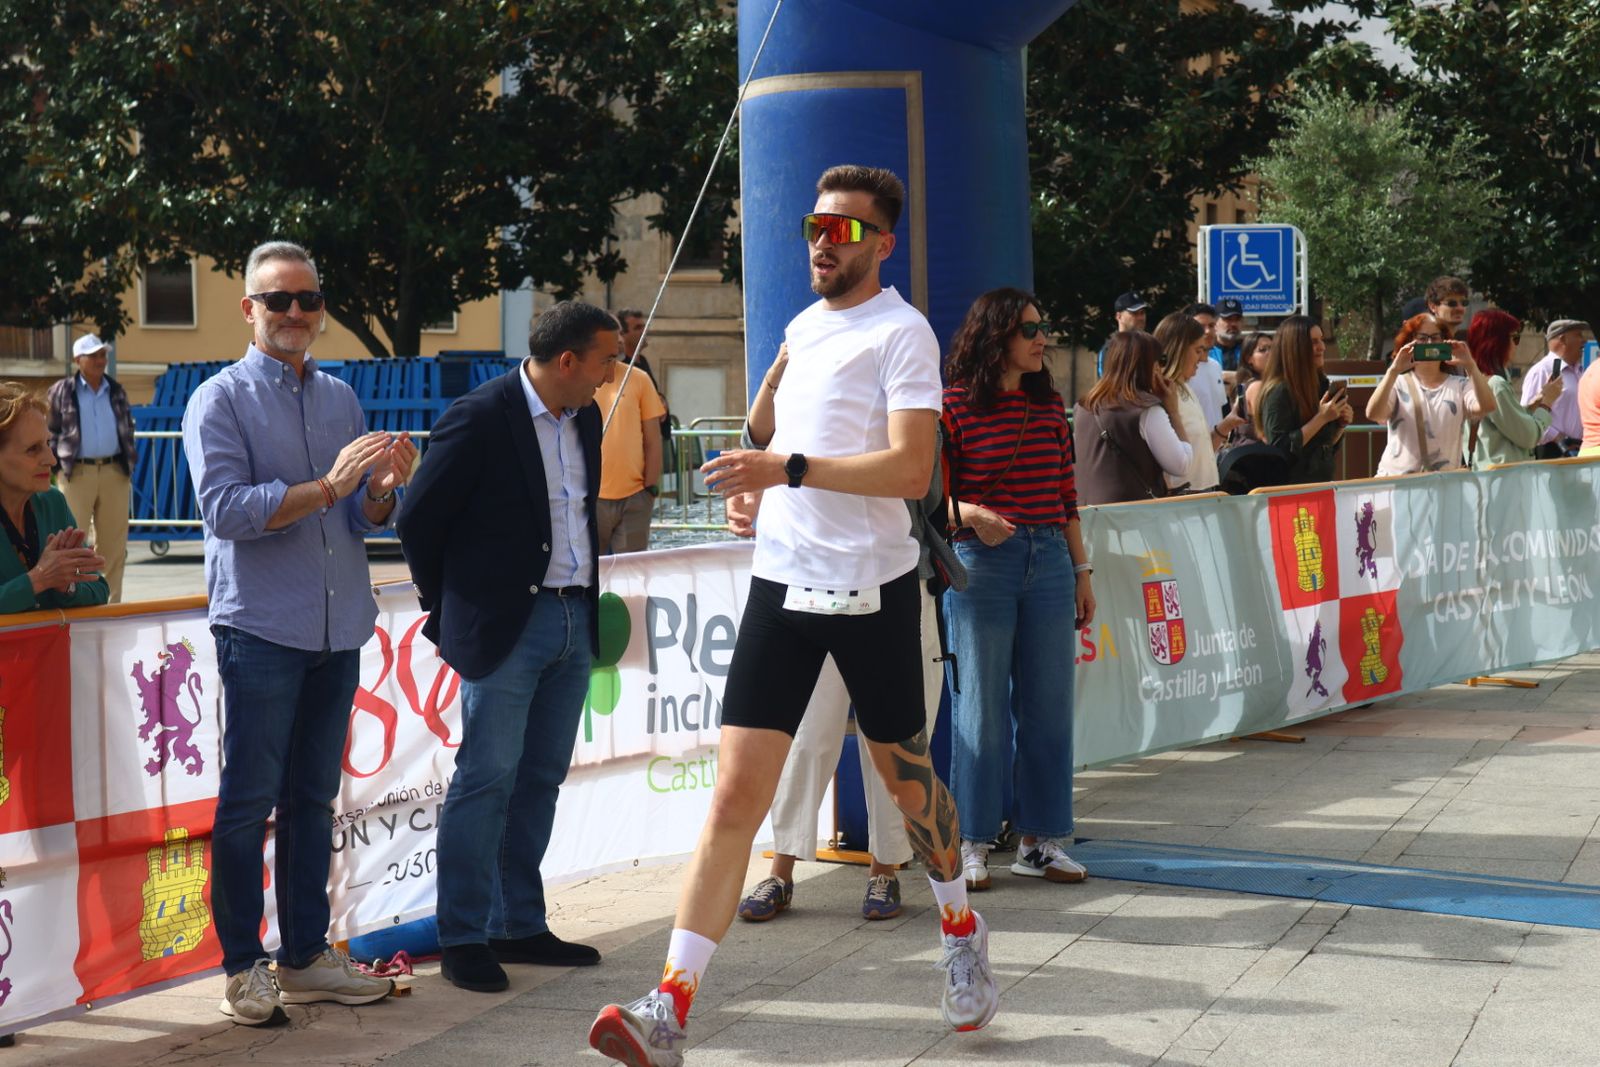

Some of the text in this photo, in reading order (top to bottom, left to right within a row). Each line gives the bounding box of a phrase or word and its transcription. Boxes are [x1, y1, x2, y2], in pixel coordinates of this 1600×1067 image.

[1442, 540, 1470, 574] DE
[1523, 577, 1538, 608] Y
[645, 591, 738, 677] Ple
[1191, 621, 1257, 659] Junta de
[1138, 662, 1263, 704] Castilla y León
[424, 779, 443, 797] de
[646, 748, 716, 793] Casti
[378, 813, 397, 841] Y
